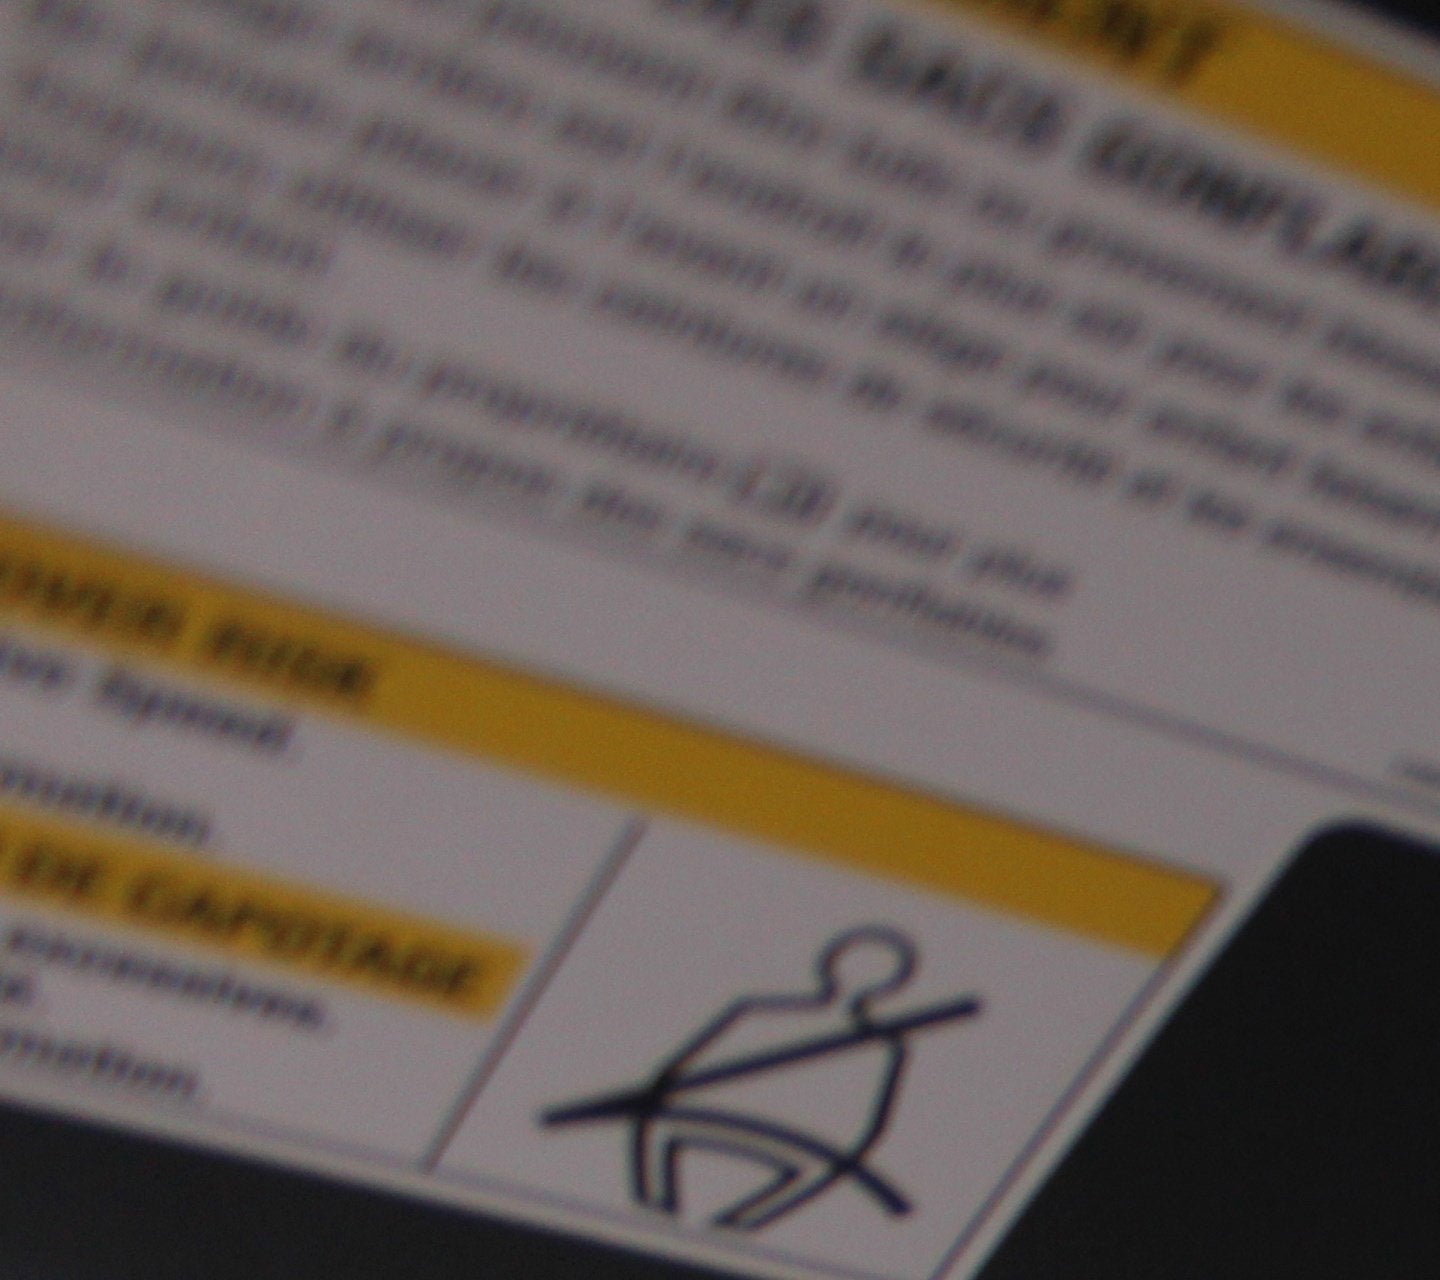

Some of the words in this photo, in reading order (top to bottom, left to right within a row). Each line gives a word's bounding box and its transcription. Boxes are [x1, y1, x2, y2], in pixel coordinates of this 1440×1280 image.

[0, 752, 214, 846] mation.
[122, 868, 486, 1002] CAPOTAGE
[0, 1022, 205, 1100] mation.
